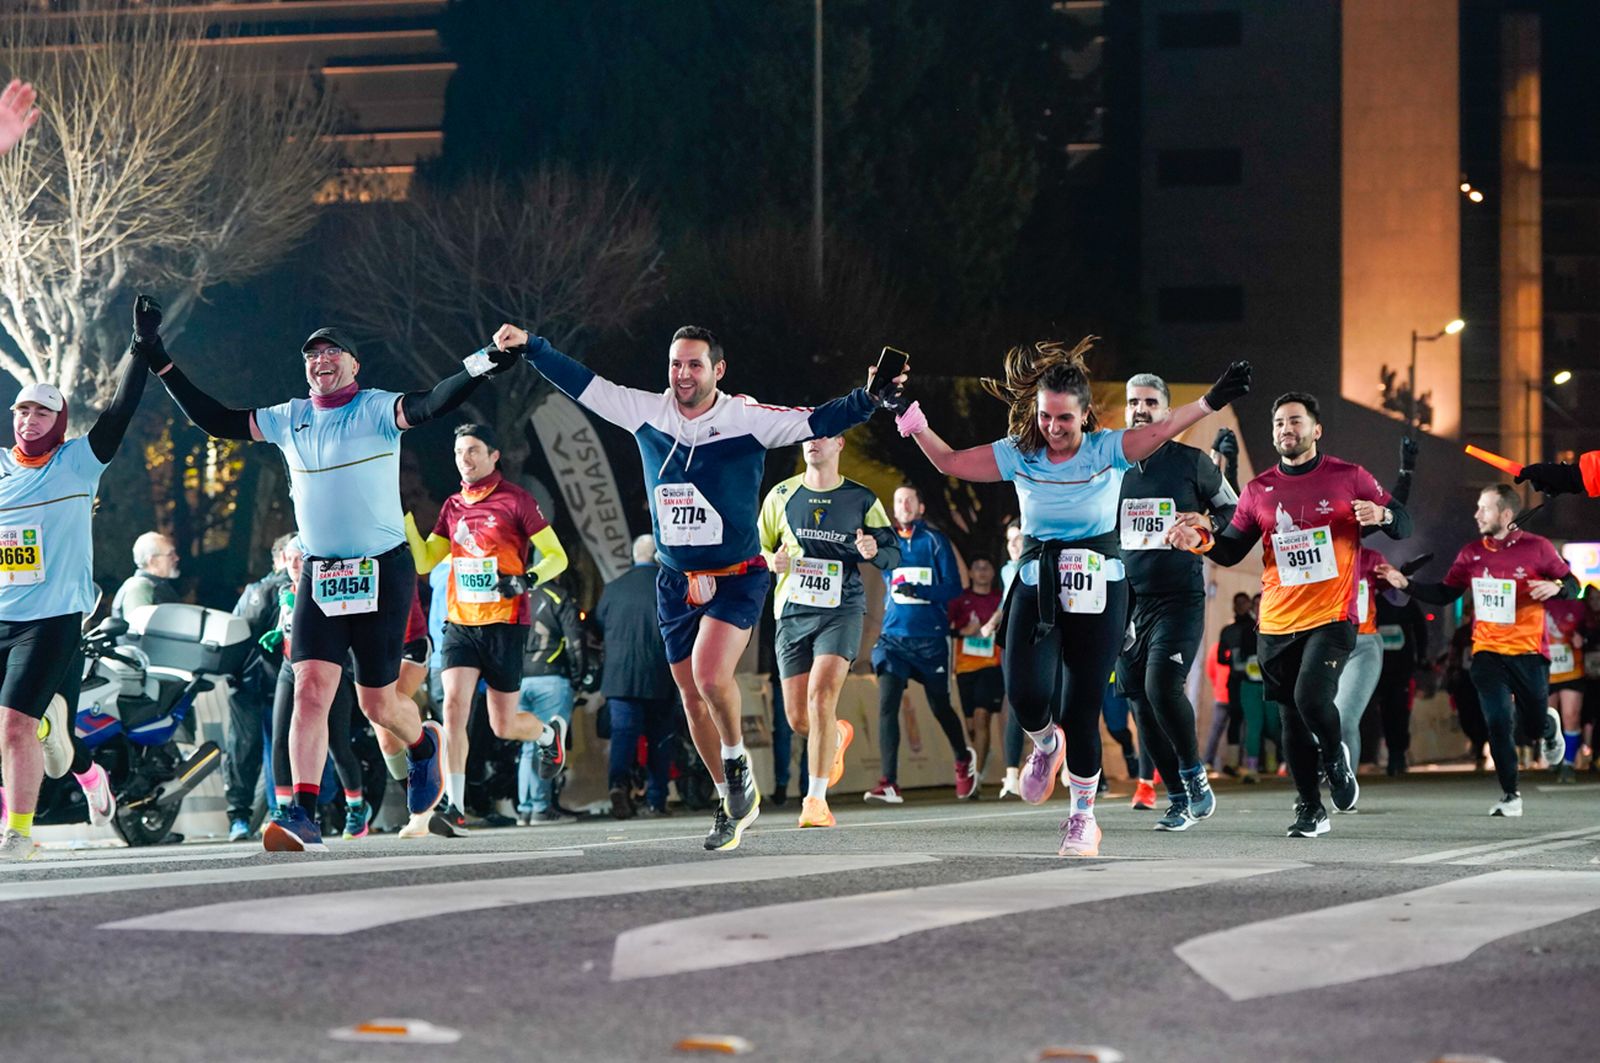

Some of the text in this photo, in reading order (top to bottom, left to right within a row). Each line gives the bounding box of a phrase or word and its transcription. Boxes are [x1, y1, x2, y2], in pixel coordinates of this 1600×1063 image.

[552, 431, 600, 547] ACIA
[664, 498, 675, 506] SAN
[671, 505, 707, 525] 2774
[1132, 517, 1164, 532] 1085
[795, 528, 847, 542] armoniza
[1287, 547, 1322, 567] 3911
[320, 576, 370, 598] 13454
[461, 573, 493, 588] 12652
[800, 574, 831, 591] 7448
[1060, 571, 1093, 591] 401
[1482, 594, 1505, 608] 7041
